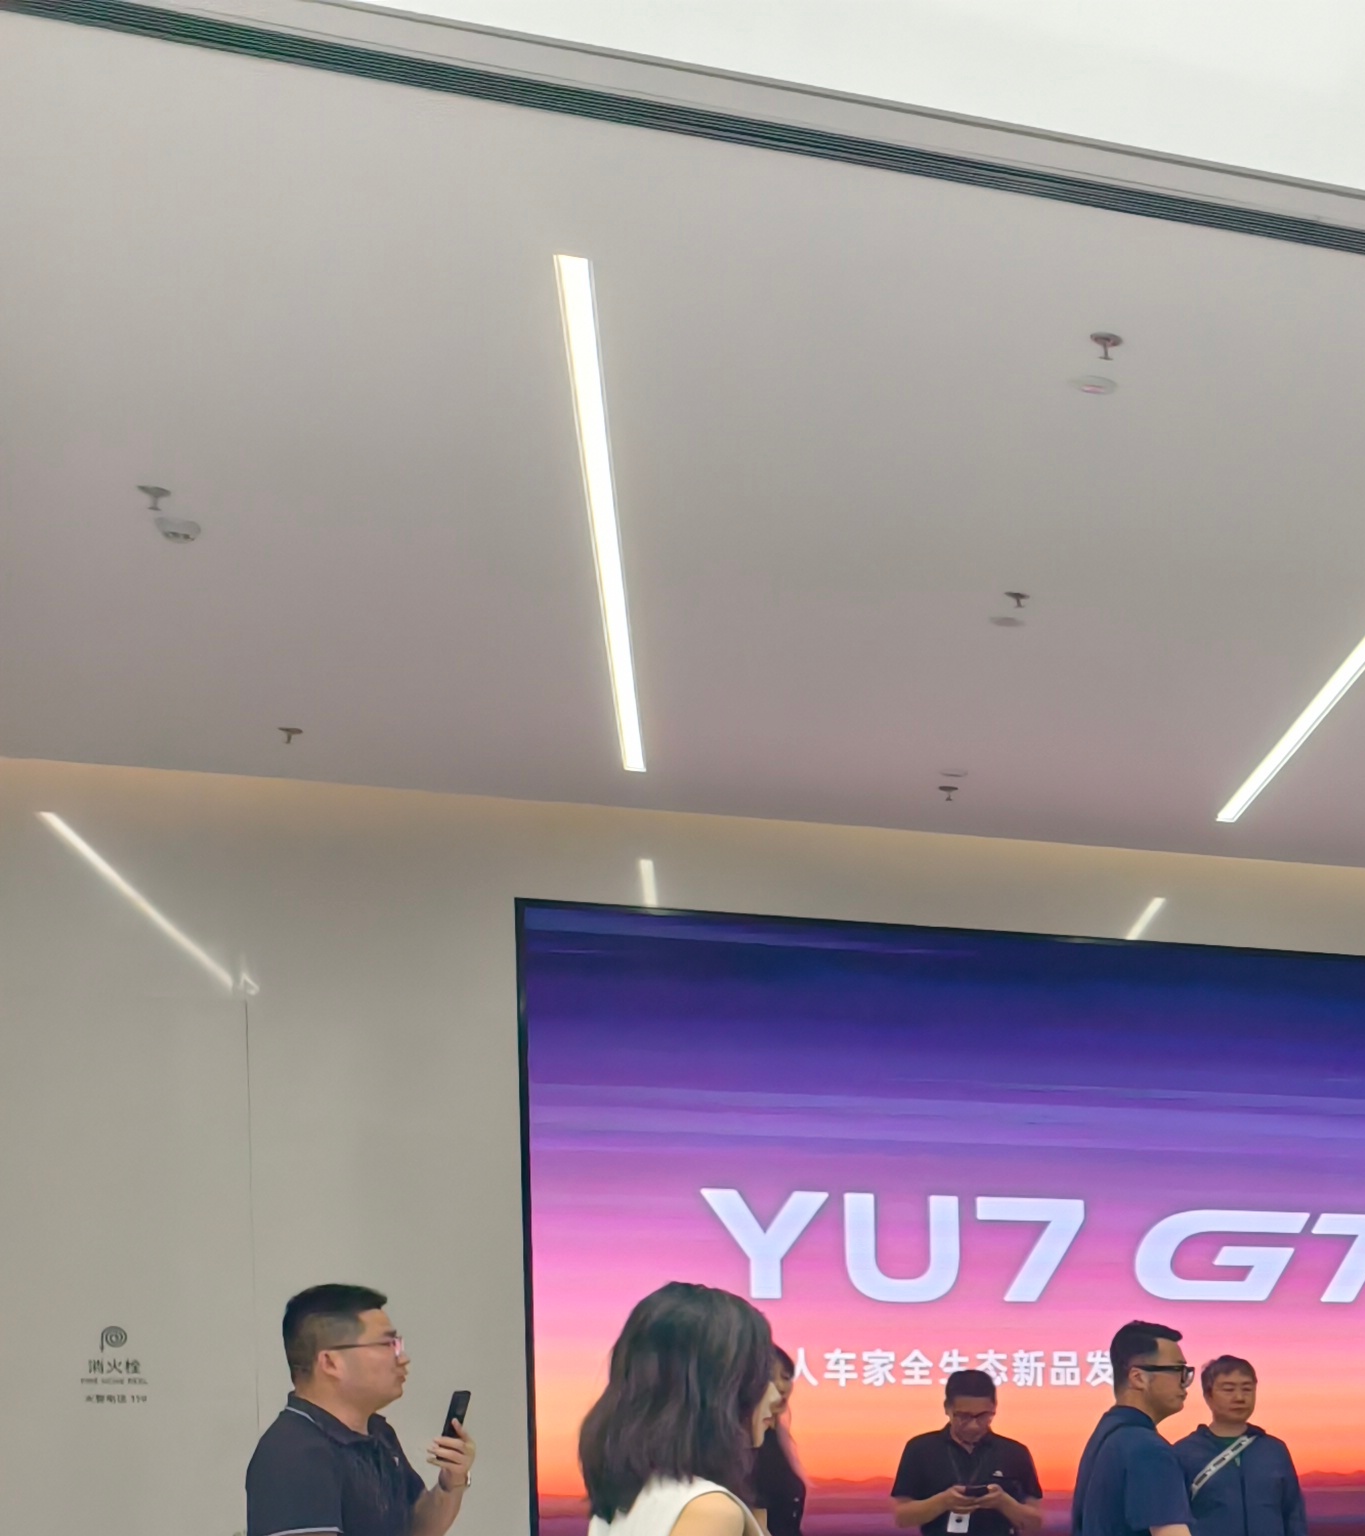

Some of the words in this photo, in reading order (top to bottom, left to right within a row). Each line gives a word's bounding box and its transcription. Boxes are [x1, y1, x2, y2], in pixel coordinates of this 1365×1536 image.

[700, 1187, 1085, 1303] YU7
[88, 1359, 141, 1374] 消火栓
